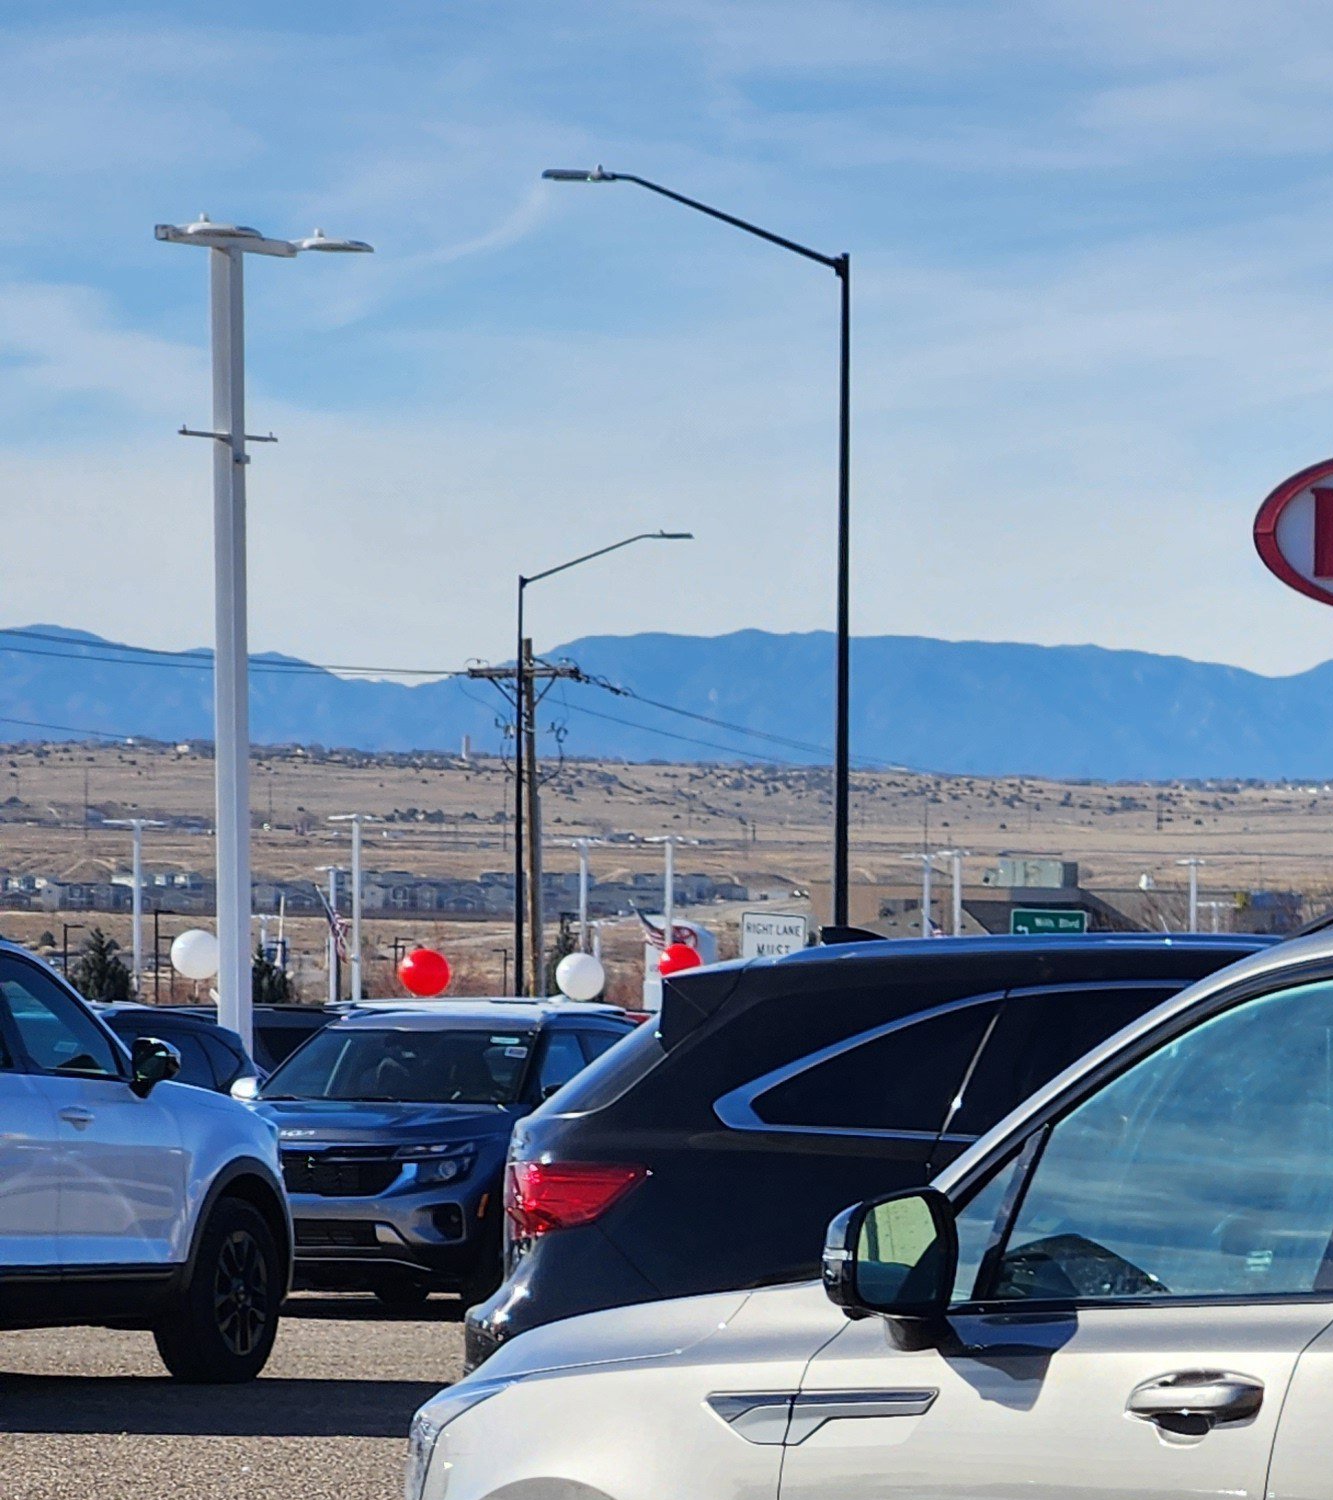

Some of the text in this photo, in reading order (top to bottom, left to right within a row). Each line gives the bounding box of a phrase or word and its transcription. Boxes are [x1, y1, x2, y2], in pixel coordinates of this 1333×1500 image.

[746, 921, 802, 937] RIGHT LANE
[756, 943, 791, 956] MUST
